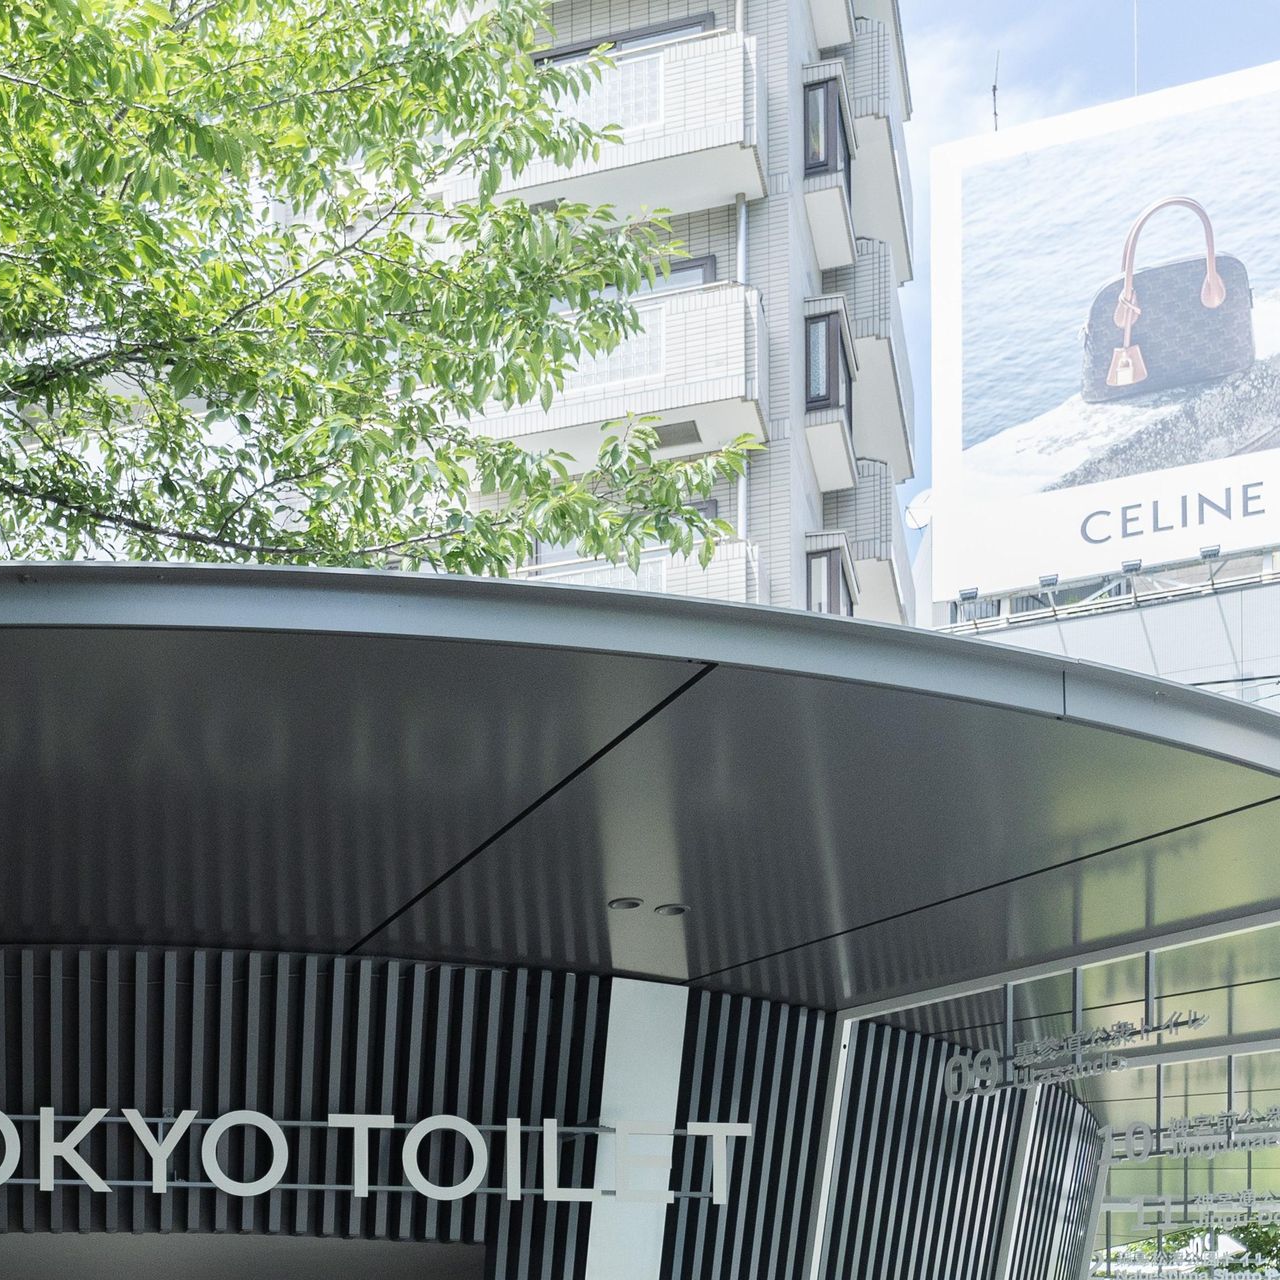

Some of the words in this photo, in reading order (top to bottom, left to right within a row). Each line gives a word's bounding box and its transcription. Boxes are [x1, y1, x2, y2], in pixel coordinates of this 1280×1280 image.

[1081, 482, 1265, 544] CELINE
[945, 1050, 1000, 1101] 09
[328, 1114, 752, 1204] TOILET
[1097, 1121, 1153, 1165] 10
